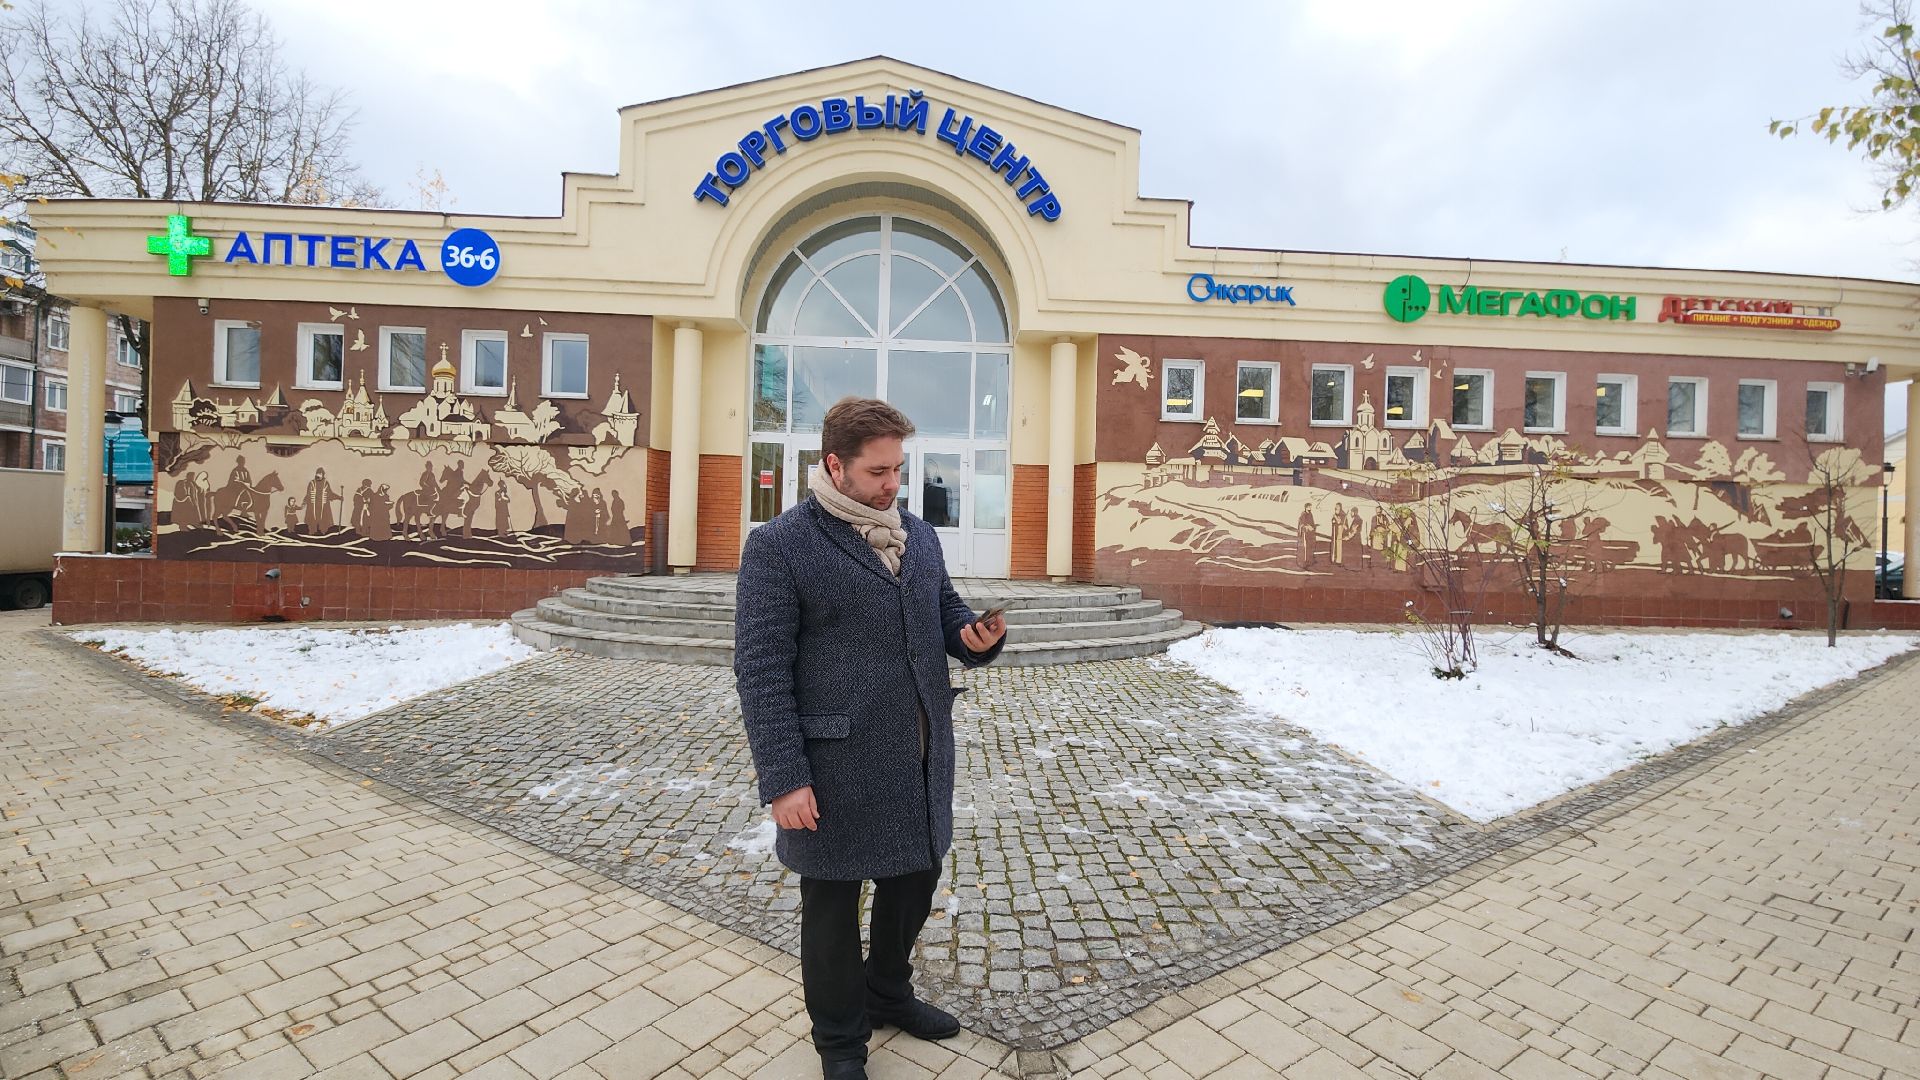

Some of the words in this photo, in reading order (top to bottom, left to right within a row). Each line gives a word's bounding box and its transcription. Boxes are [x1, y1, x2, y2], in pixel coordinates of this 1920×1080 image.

[694, 88, 929, 207] ТОРГОВЫЙ
[937, 107, 1062, 222] ЦЕНТР
[225, 231, 427, 272] АПТЕКА
[1693, 313, 1731, 323] ПИТАНИЕ
[1740, 315, 1794, 326] ПОДГУЗНИКИ
[1803, 318, 1838, 329] ОДЕЖДА
